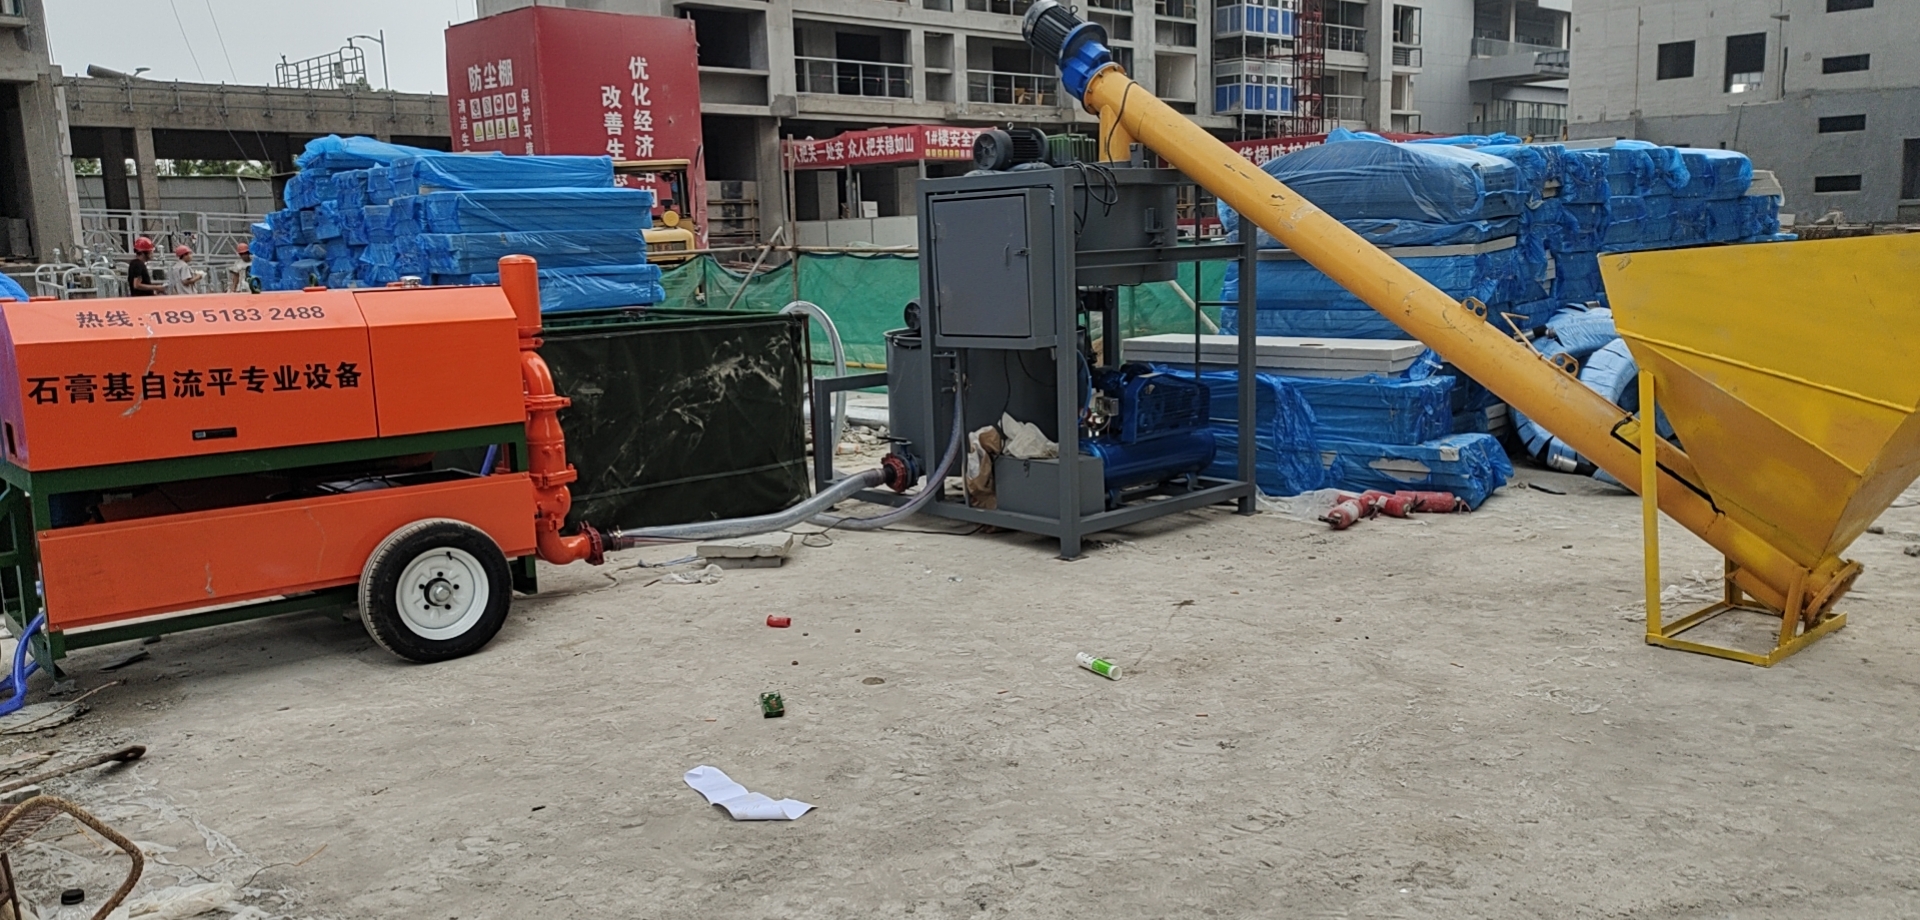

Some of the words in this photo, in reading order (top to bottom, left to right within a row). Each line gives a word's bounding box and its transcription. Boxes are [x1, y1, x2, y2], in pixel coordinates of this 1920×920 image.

[467, 58, 514, 93] 防尘棚
[457, 98, 471, 153] 清洁生
[848, 133, 914, 158] 众人把关稳如山
[151, 310, 195, 325] 189
[202, 308, 262, 323] 5183
[269, 306, 325, 321] 2488
[27, 362, 362, 404] 石膏基自流平专业设备
